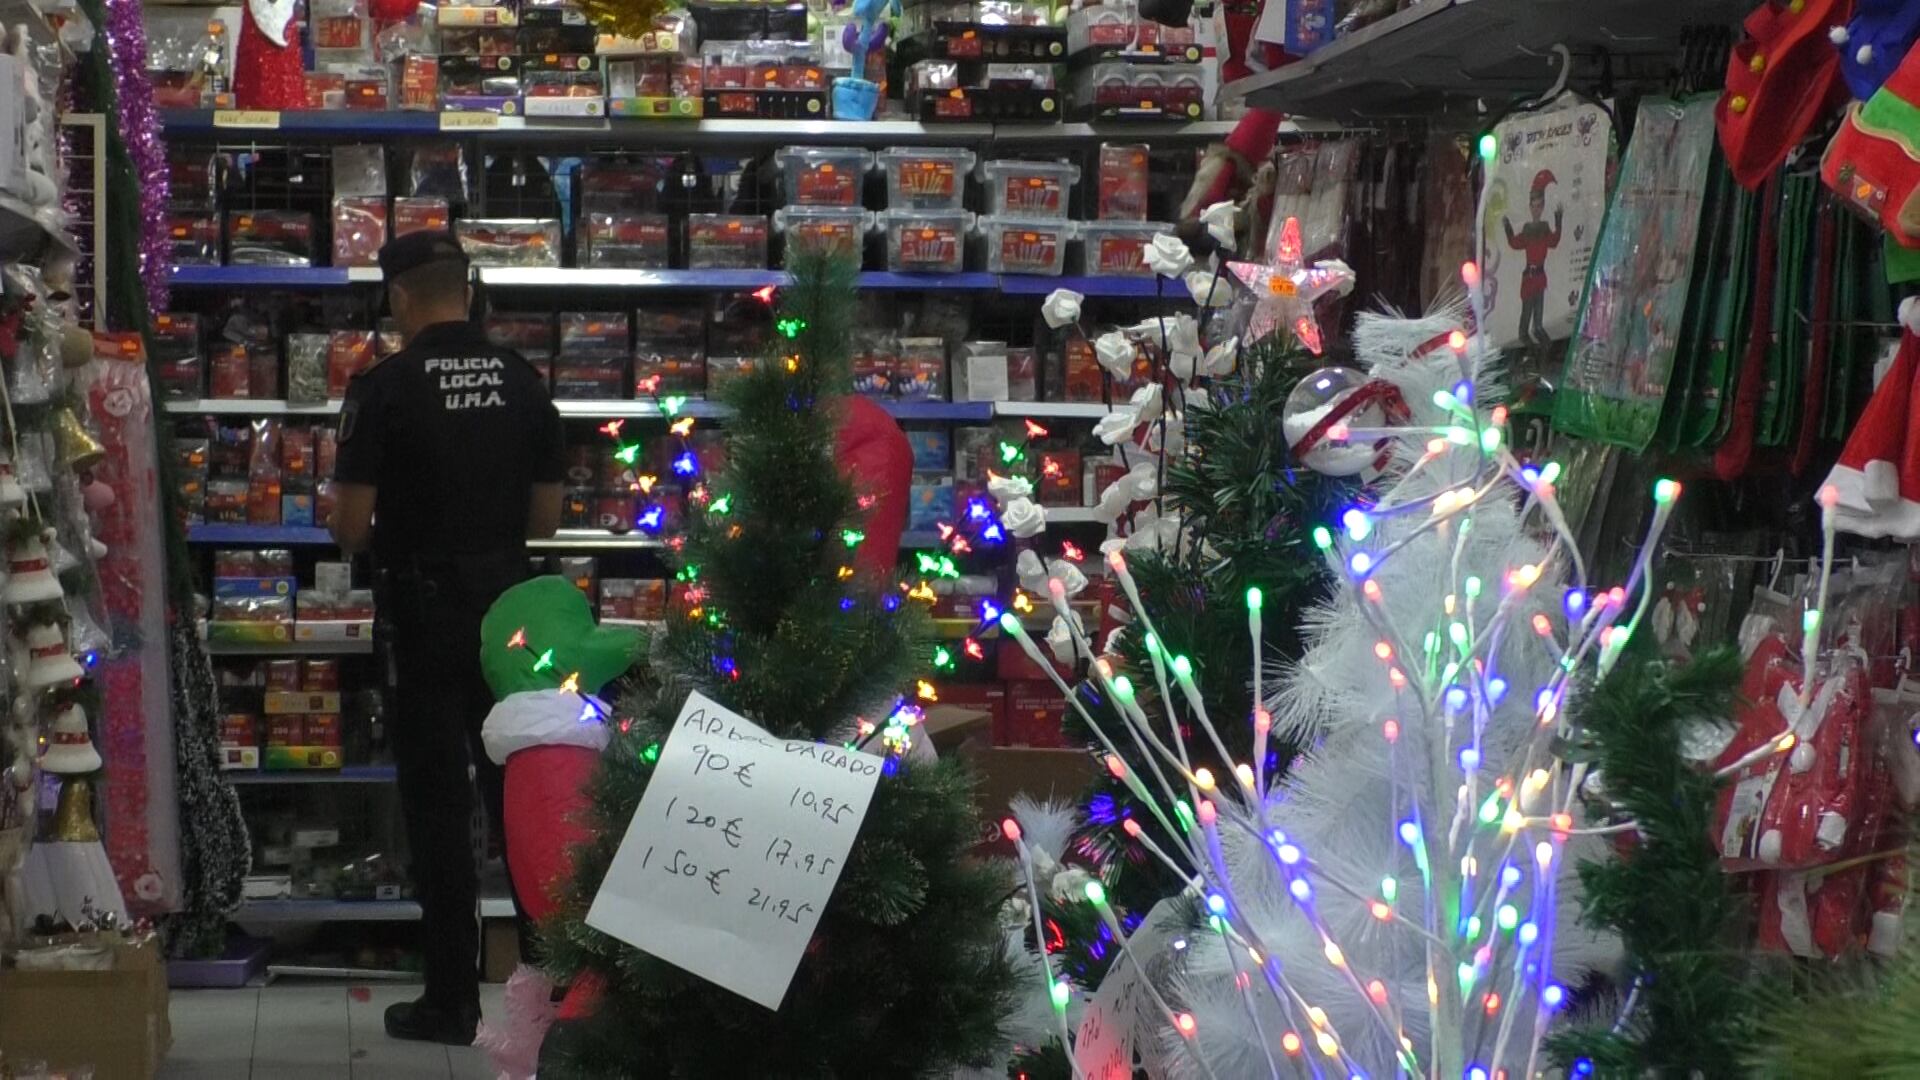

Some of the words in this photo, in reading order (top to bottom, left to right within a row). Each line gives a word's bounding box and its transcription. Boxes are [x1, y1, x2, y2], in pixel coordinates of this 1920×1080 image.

[424, 357, 504, 373] POLICIA
[440, 373, 503, 389] LOCAL
[445, 391, 506, 409] U.M.A.
